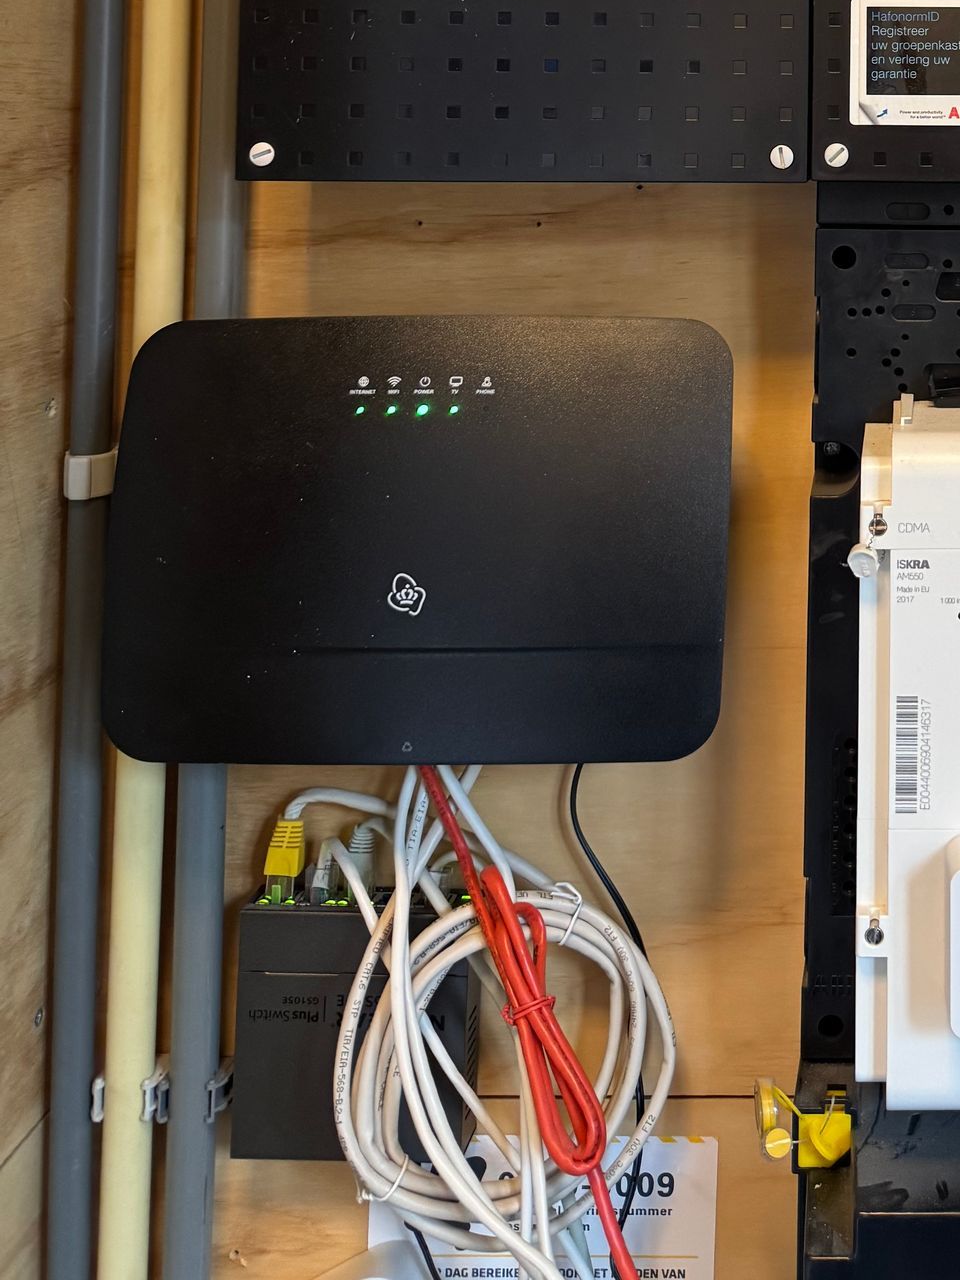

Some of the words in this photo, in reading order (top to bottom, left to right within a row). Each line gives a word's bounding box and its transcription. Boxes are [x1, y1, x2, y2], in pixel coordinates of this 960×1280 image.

[871, 11, 940, 22] HafonormID
[871, 25, 930, 38] Registreer
[871, 41, 888, 51] uw
[871, 55, 885, 65] en
[888, 55, 930, 67] verleng
[933, 55, 951, 65] uw
[871, 68, 917, 81] garantie
[897, 522, 930, 534] CDMA
[896, 559, 930, 570] ISKRA
[896, 572, 924, 581] AM550
[896, 585, 913, 593] Made
[896, 595, 915, 603] 2017
[358, 959, 375, 991] CAT.6
[282, 996, 319, 1005] GS105E
[351, 999, 361, 1019] STP
[248, 1008, 291, 1023] Switch
[293, 1010, 319, 1023] Plus
[625, 1138, 641, 1156] 30V
[641, 1113, 657, 1134] FT2
[445, 1267, 469, 1279] DAG
[471, 1267, 520, 1279] BEREIKE
[661, 1268, 687, 1280] VAN
